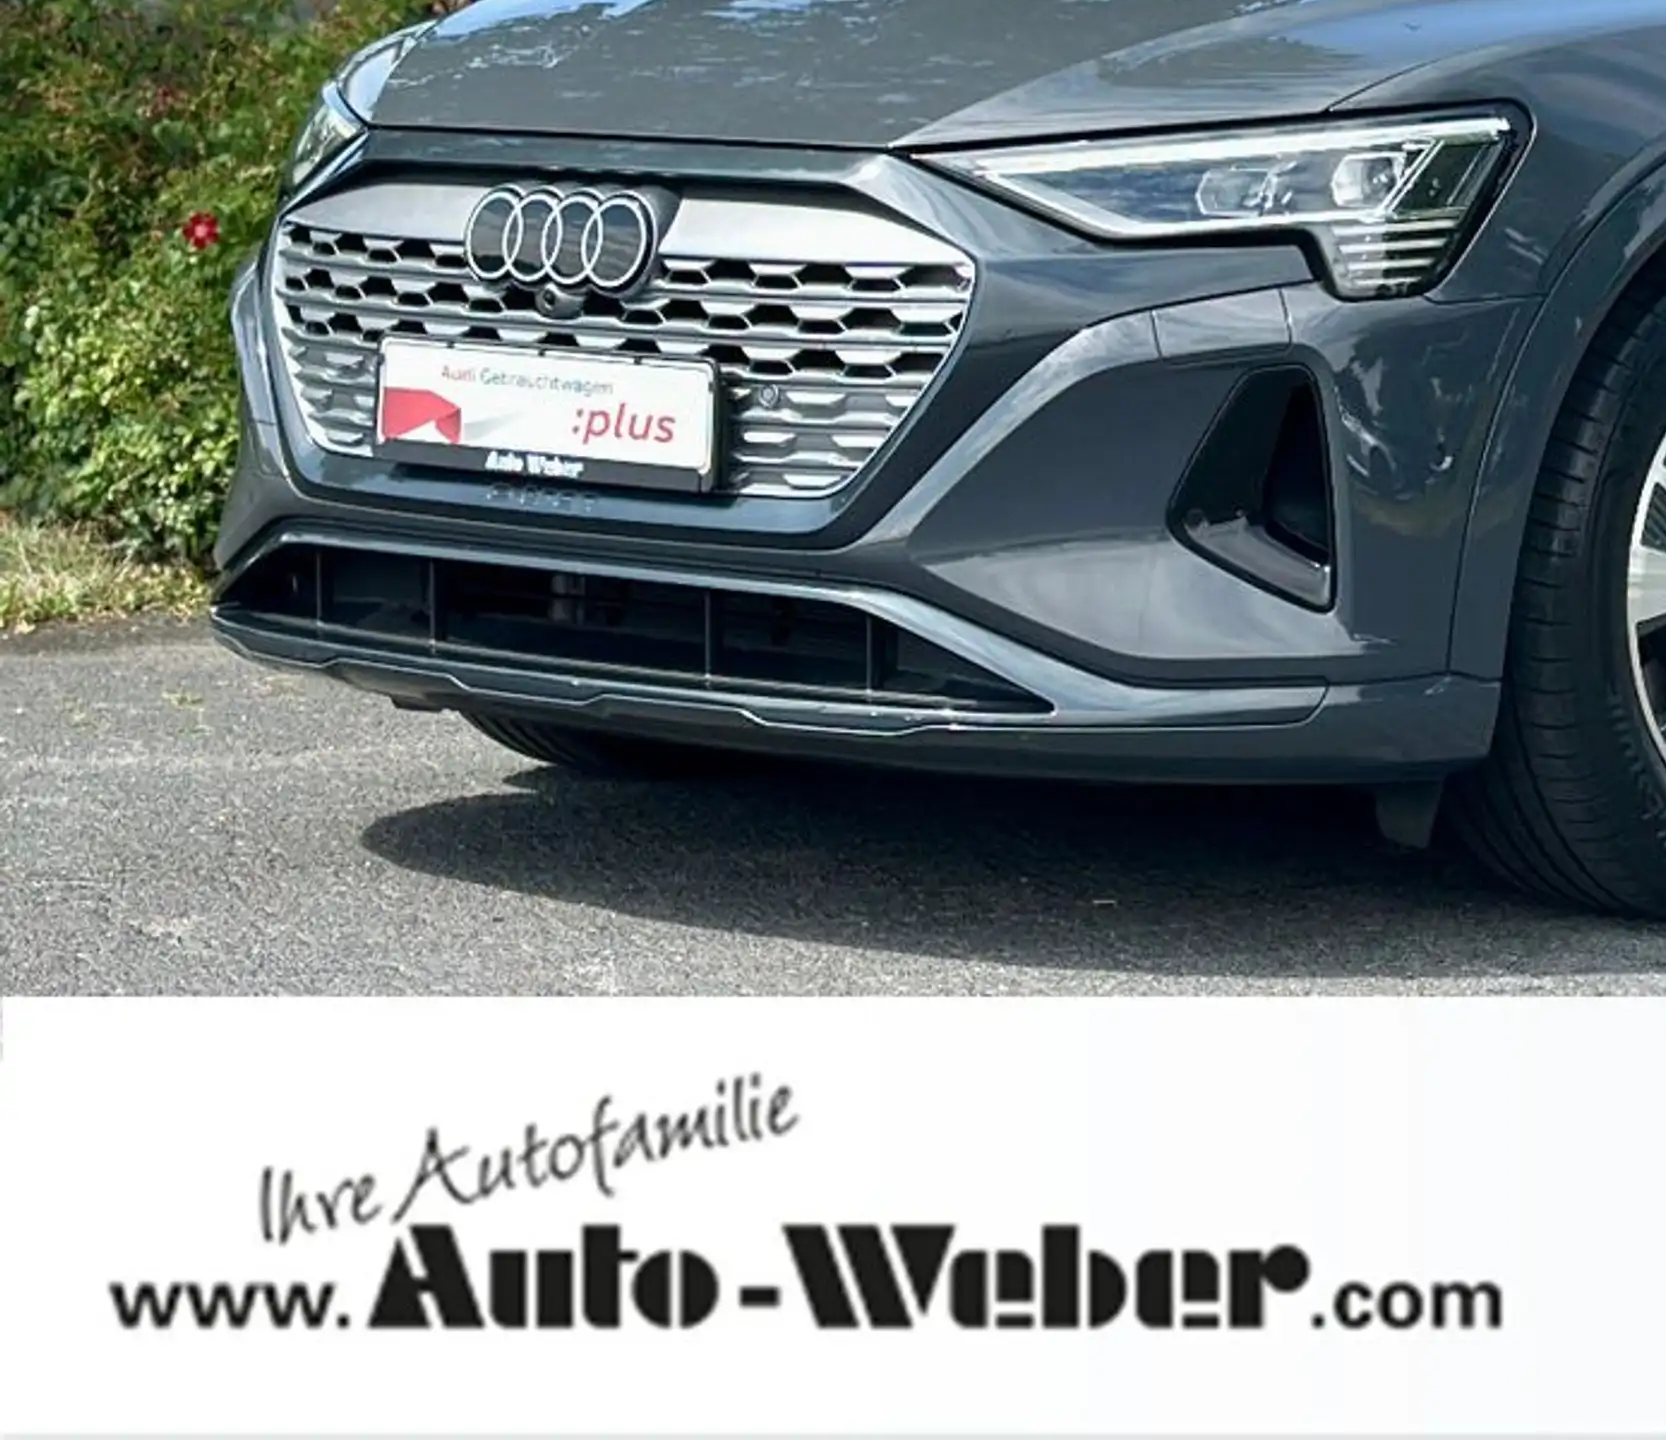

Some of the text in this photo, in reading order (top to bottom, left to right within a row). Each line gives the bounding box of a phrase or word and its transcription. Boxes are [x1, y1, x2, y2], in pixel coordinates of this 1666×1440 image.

[441, 364, 614, 398] Audi Gebrauchtwagen
[571, 402, 677, 445] :plus
[484, 450, 585, 479] Auto Weber
